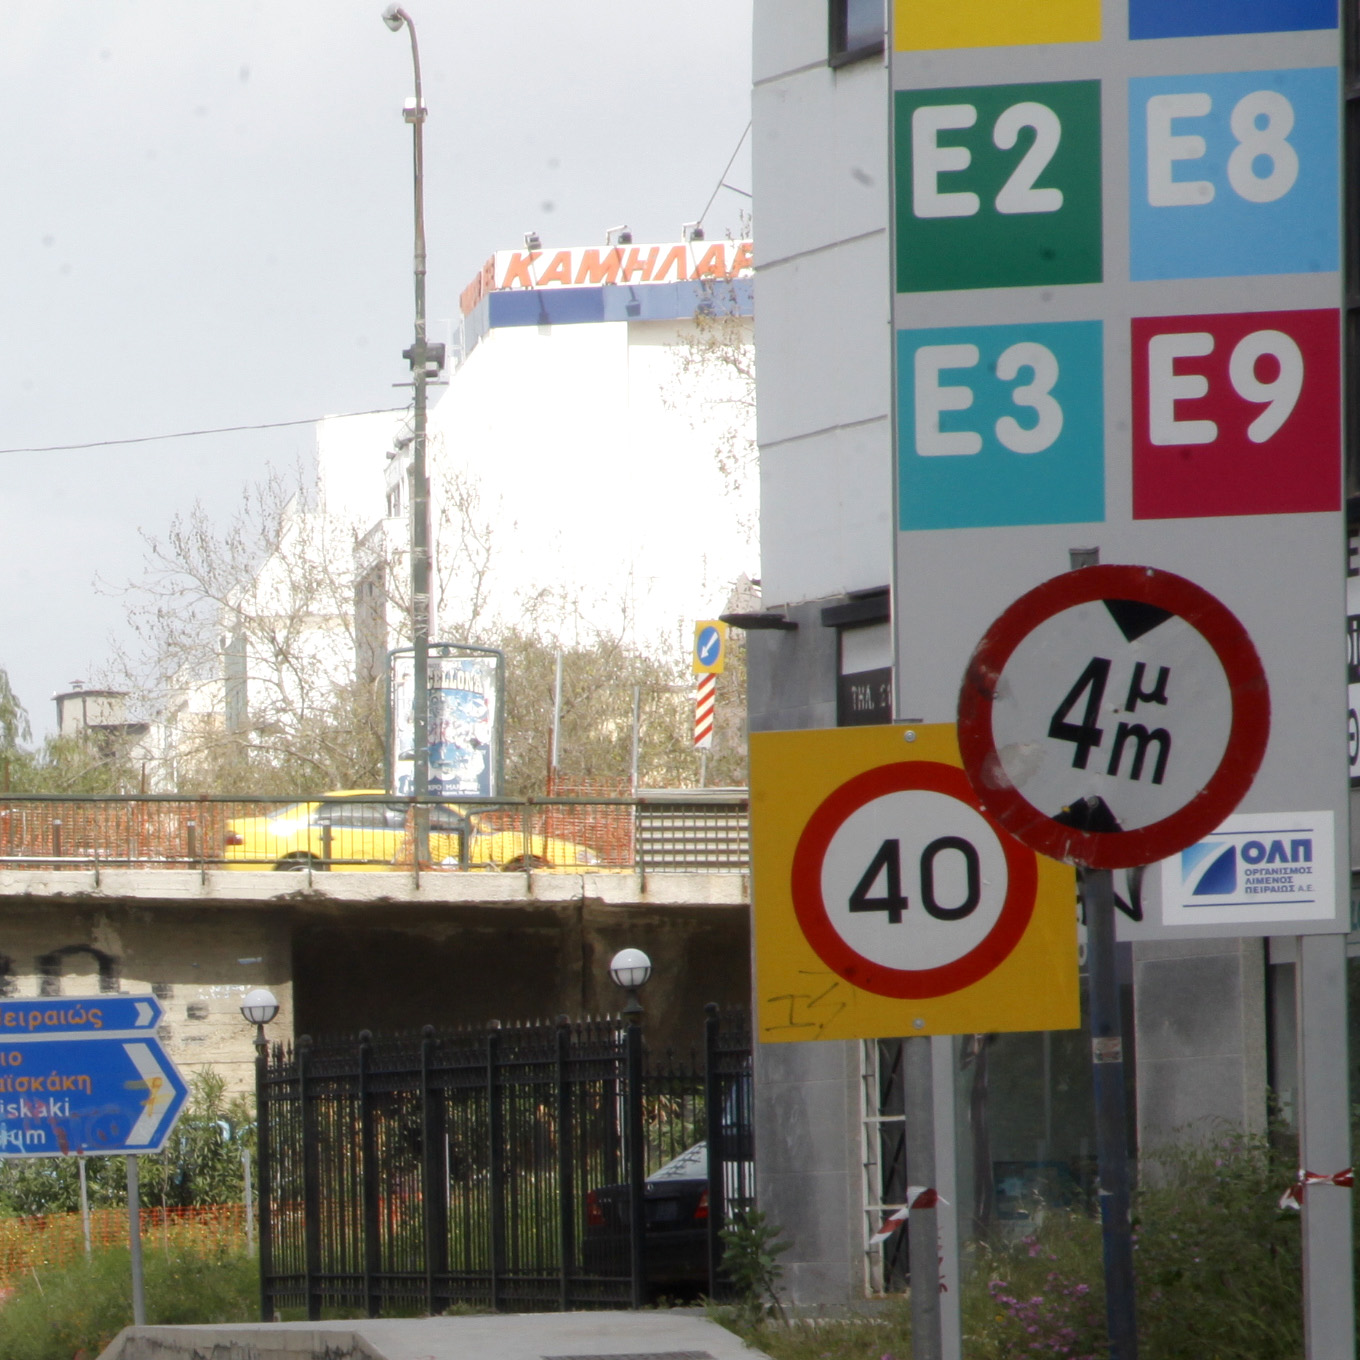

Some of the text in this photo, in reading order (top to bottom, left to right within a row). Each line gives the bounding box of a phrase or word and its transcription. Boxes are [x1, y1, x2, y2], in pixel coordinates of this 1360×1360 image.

[912, 101, 1064, 218] E2
[1146, 89, 1299, 208] E8
[914, 341, 1064, 457] E3
[1148, 329, 1305, 447] E9
[848, 835, 982, 924] 40
[1240, 838, 1314, 865] ΟΛΠ
[1245, 867, 1312, 875] ΟΡΓΑΝΙΣΜΟΣ
[1245, 876, 1293, 884] ΛΙΜΕΝΟΣ
[1245, 885, 1295, 894] ΠΕΙΡΑΙΩΣ
